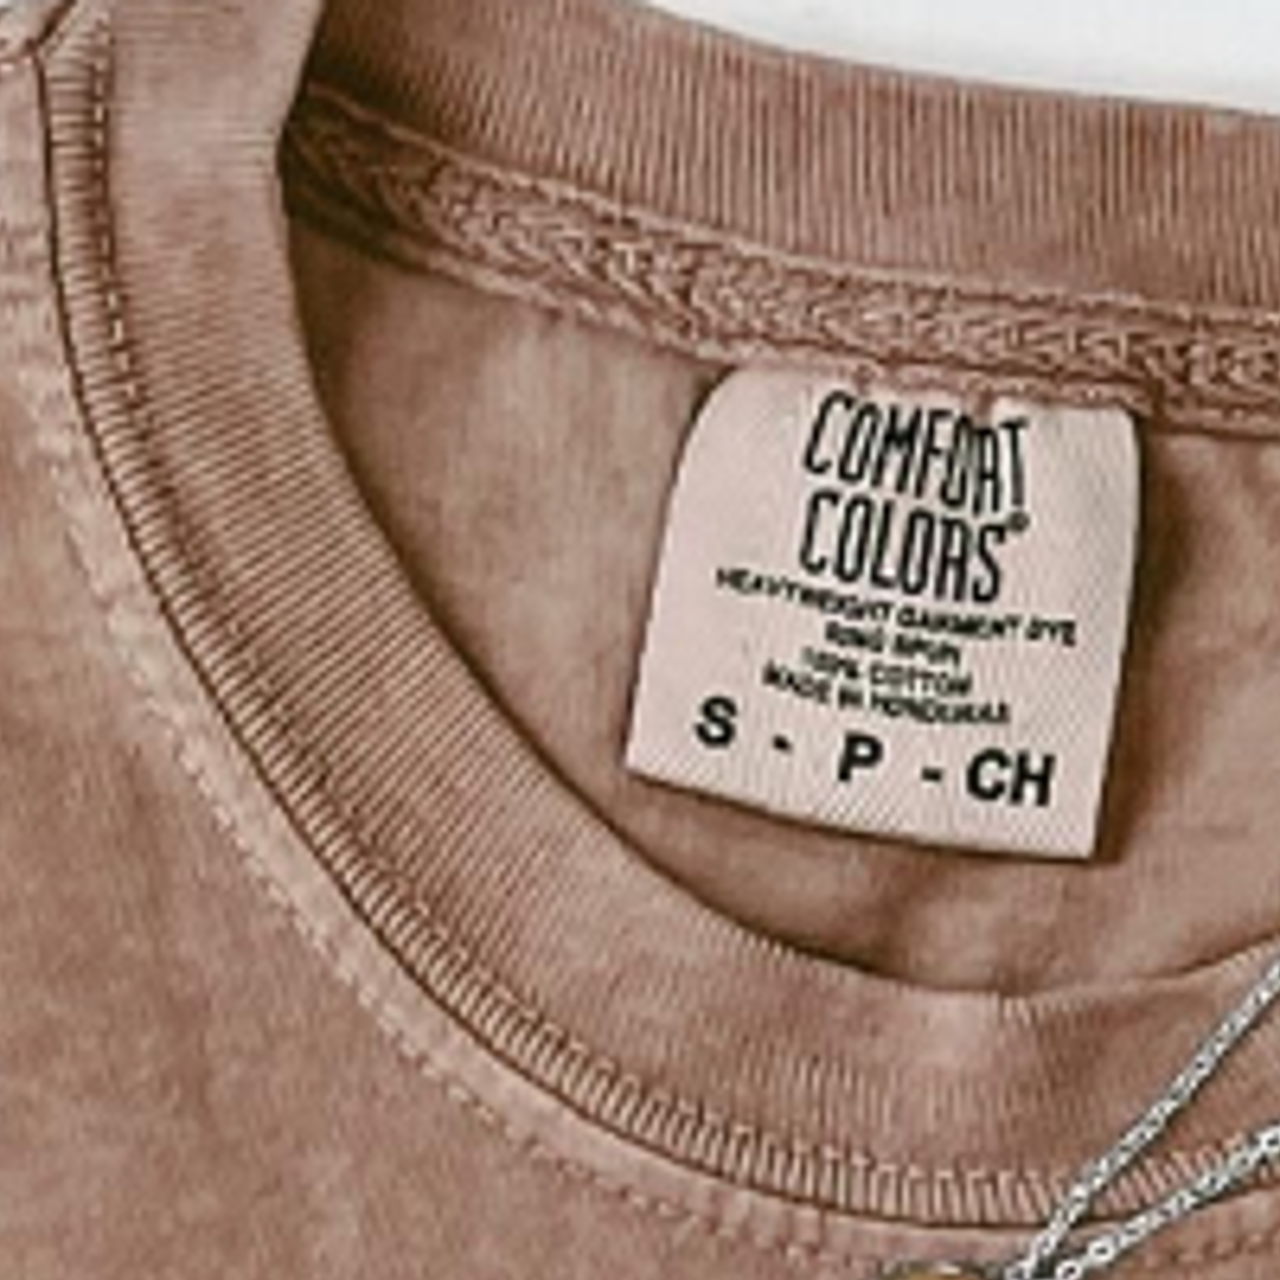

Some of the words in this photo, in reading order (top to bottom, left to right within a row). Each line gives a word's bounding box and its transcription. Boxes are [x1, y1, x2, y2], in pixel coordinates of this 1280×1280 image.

[802, 391, 1029, 516] COMFORT
[1025, 616, 1077, 647] DYE
[870, 660, 973, 697] COTTON
[693, 696, 740, 748] S
[836, 733, 883, 783] P
